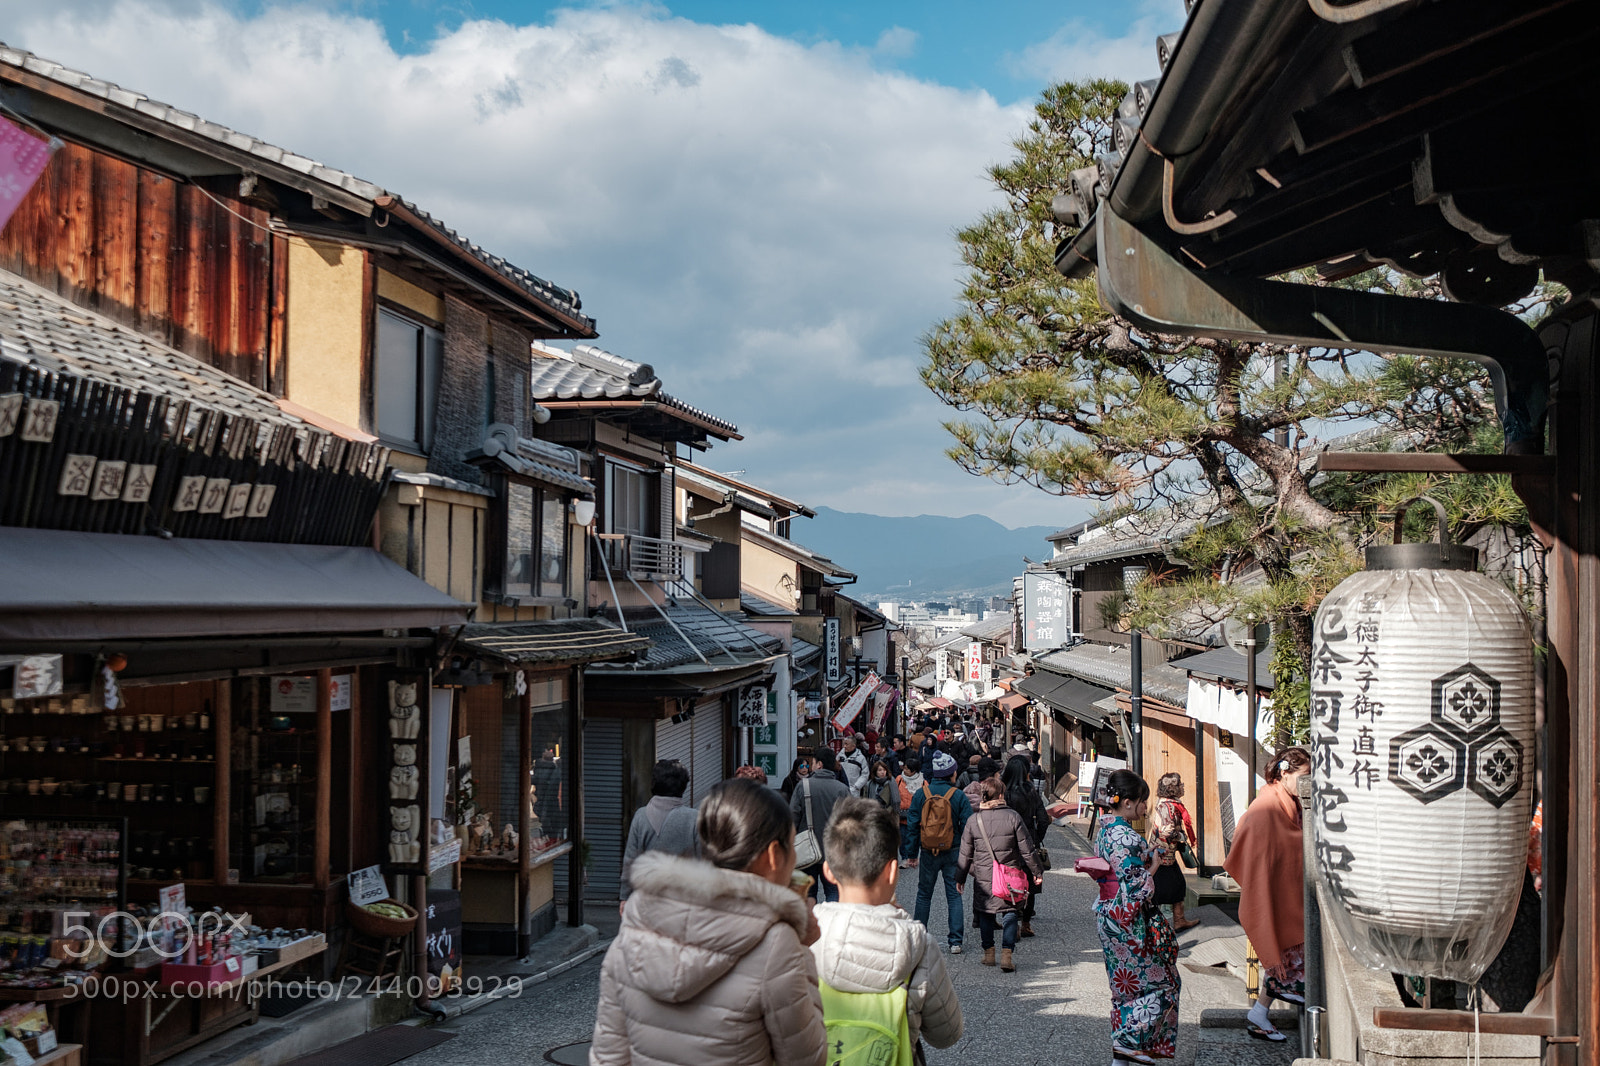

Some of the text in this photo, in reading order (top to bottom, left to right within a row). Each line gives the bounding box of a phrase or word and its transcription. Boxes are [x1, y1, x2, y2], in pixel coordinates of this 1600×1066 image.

[1036, 580, 1054, 640] 森陶器館
[751, 689, 764, 726] 西陣織
[1348, 591, 1387, 791] 聖徳太子御直作
